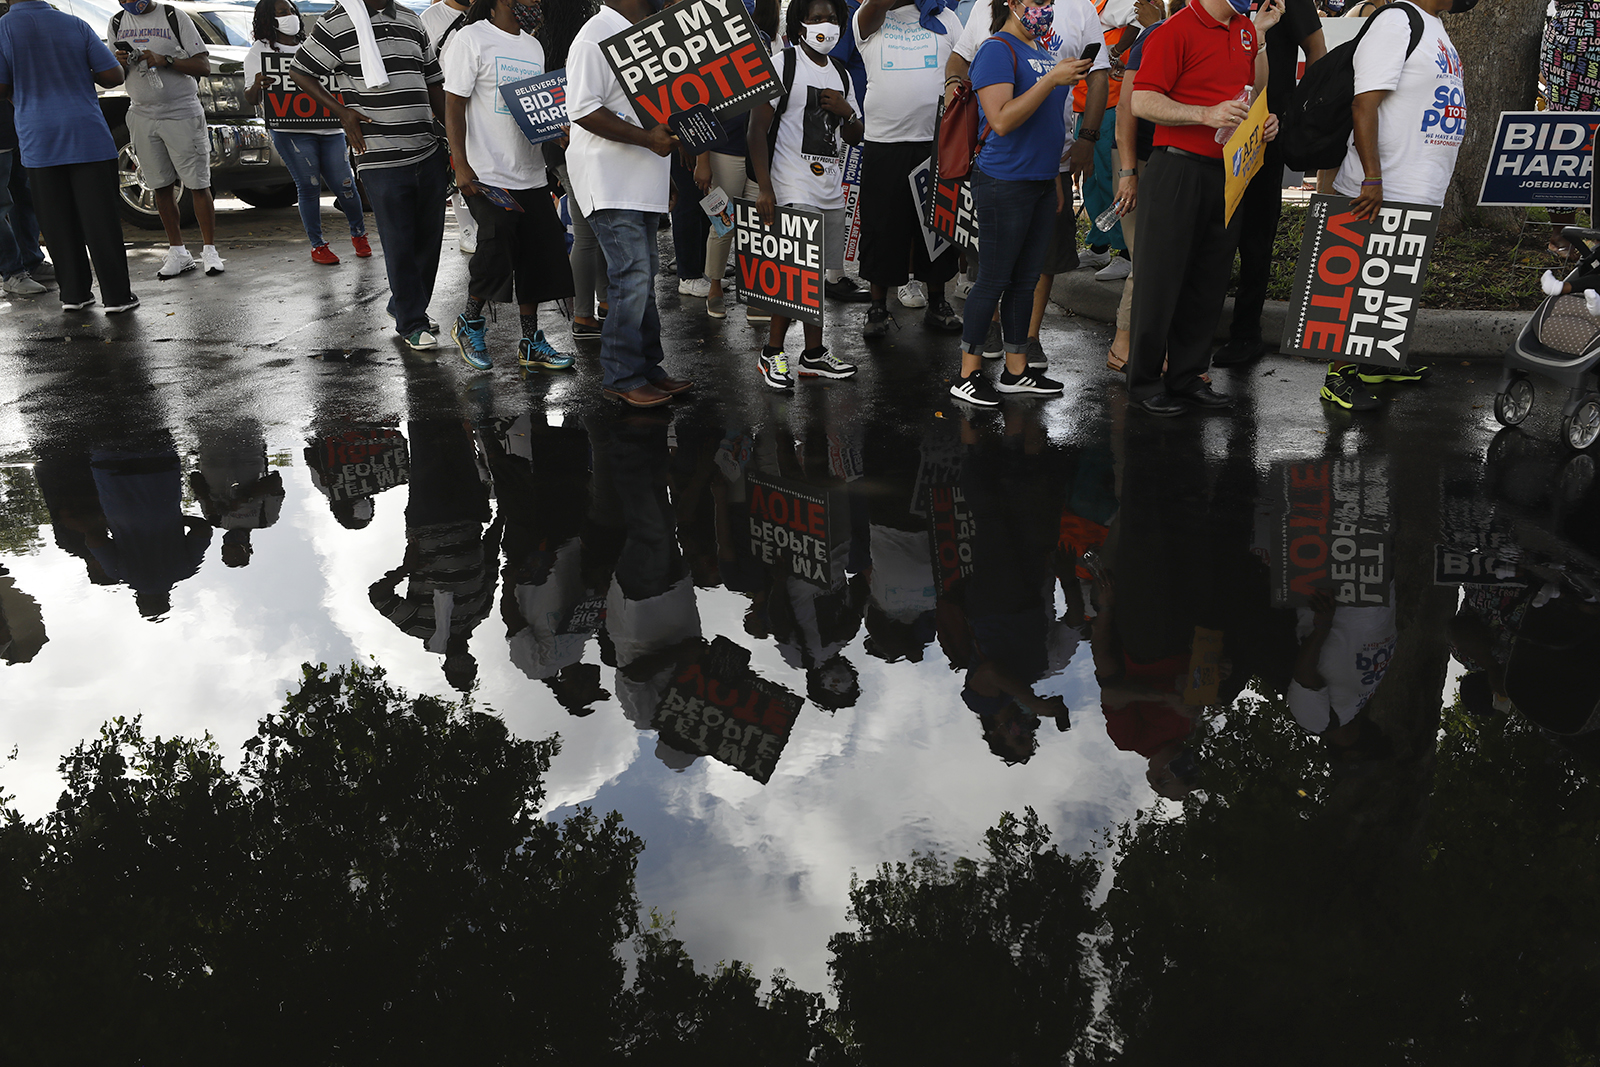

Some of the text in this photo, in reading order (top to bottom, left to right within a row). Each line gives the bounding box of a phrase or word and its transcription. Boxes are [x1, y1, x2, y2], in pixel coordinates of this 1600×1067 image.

[607, 0, 729, 69] LET MY
[265, 57, 296, 73] LE
[621, 14, 751, 94] PEOPLE
[500, 64, 519, 74] Make
[515, 78, 557, 96] BELIEVERS
[636, 43, 771, 125] VOTE
[527, 104, 568, 126] HARR
[1448, 107, 1460, 117] TO
[845, 147, 860, 181] AMERICA
[1495, 154, 1593, 177] HARR
[1519, 181, 1592, 189] JOEBIDEN.C
[845, 191, 857, 219] LOVE
[781, 213, 819, 241] MY
[737, 229, 819, 268] PEOPLE
[846, 238, 856, 258] EQUAL
[738, 254, 820, 308] VOTE
[1302, 211, 1371, 353] VOTE
[1345, 207, 1403, 357] PEOPLE
[1377, 210, 1433, 361] LET MY
